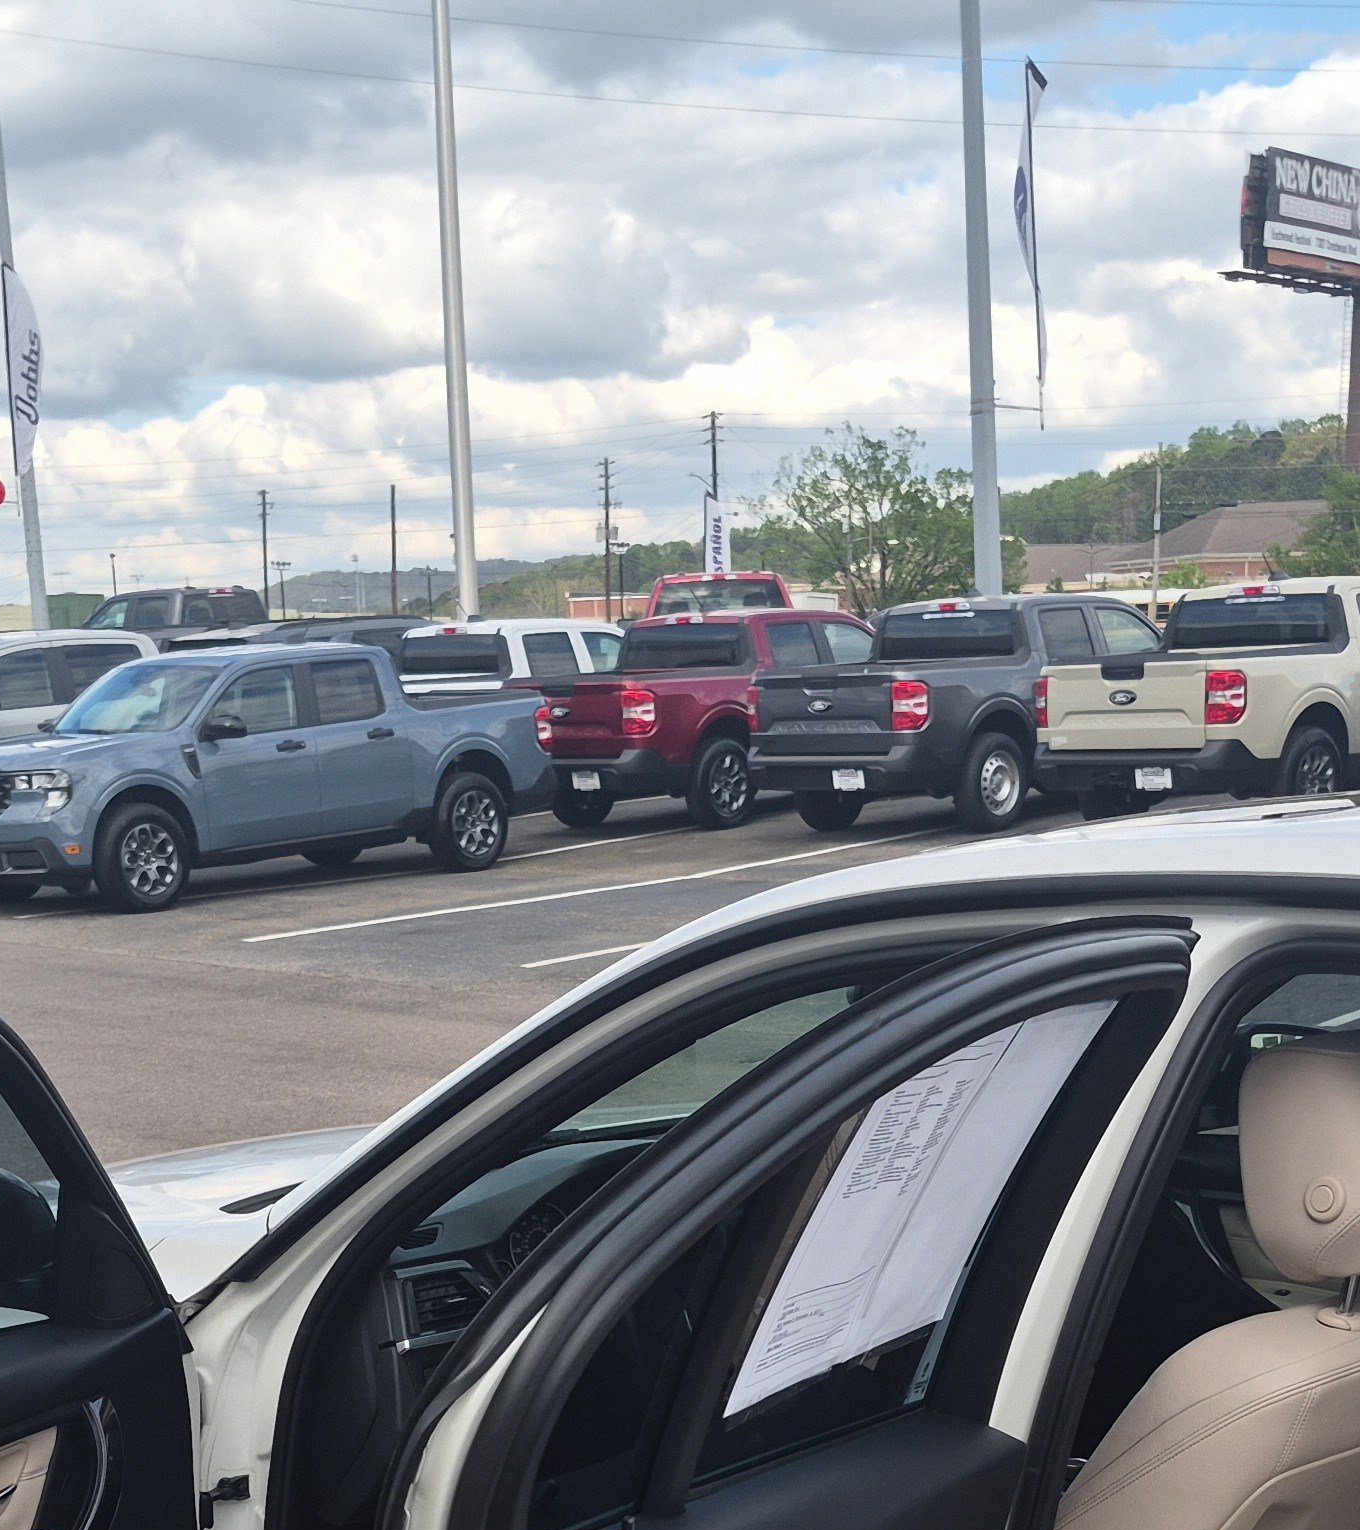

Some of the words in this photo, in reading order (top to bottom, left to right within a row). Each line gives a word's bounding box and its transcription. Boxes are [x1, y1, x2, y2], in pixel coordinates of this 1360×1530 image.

[1274, 157, 1310, 195] NEW
[1311, 165, 1360, 205] CHINA
[15, 329, 42, 426] Dobbs
[710, 515, 724, 572] SPAÑOL
